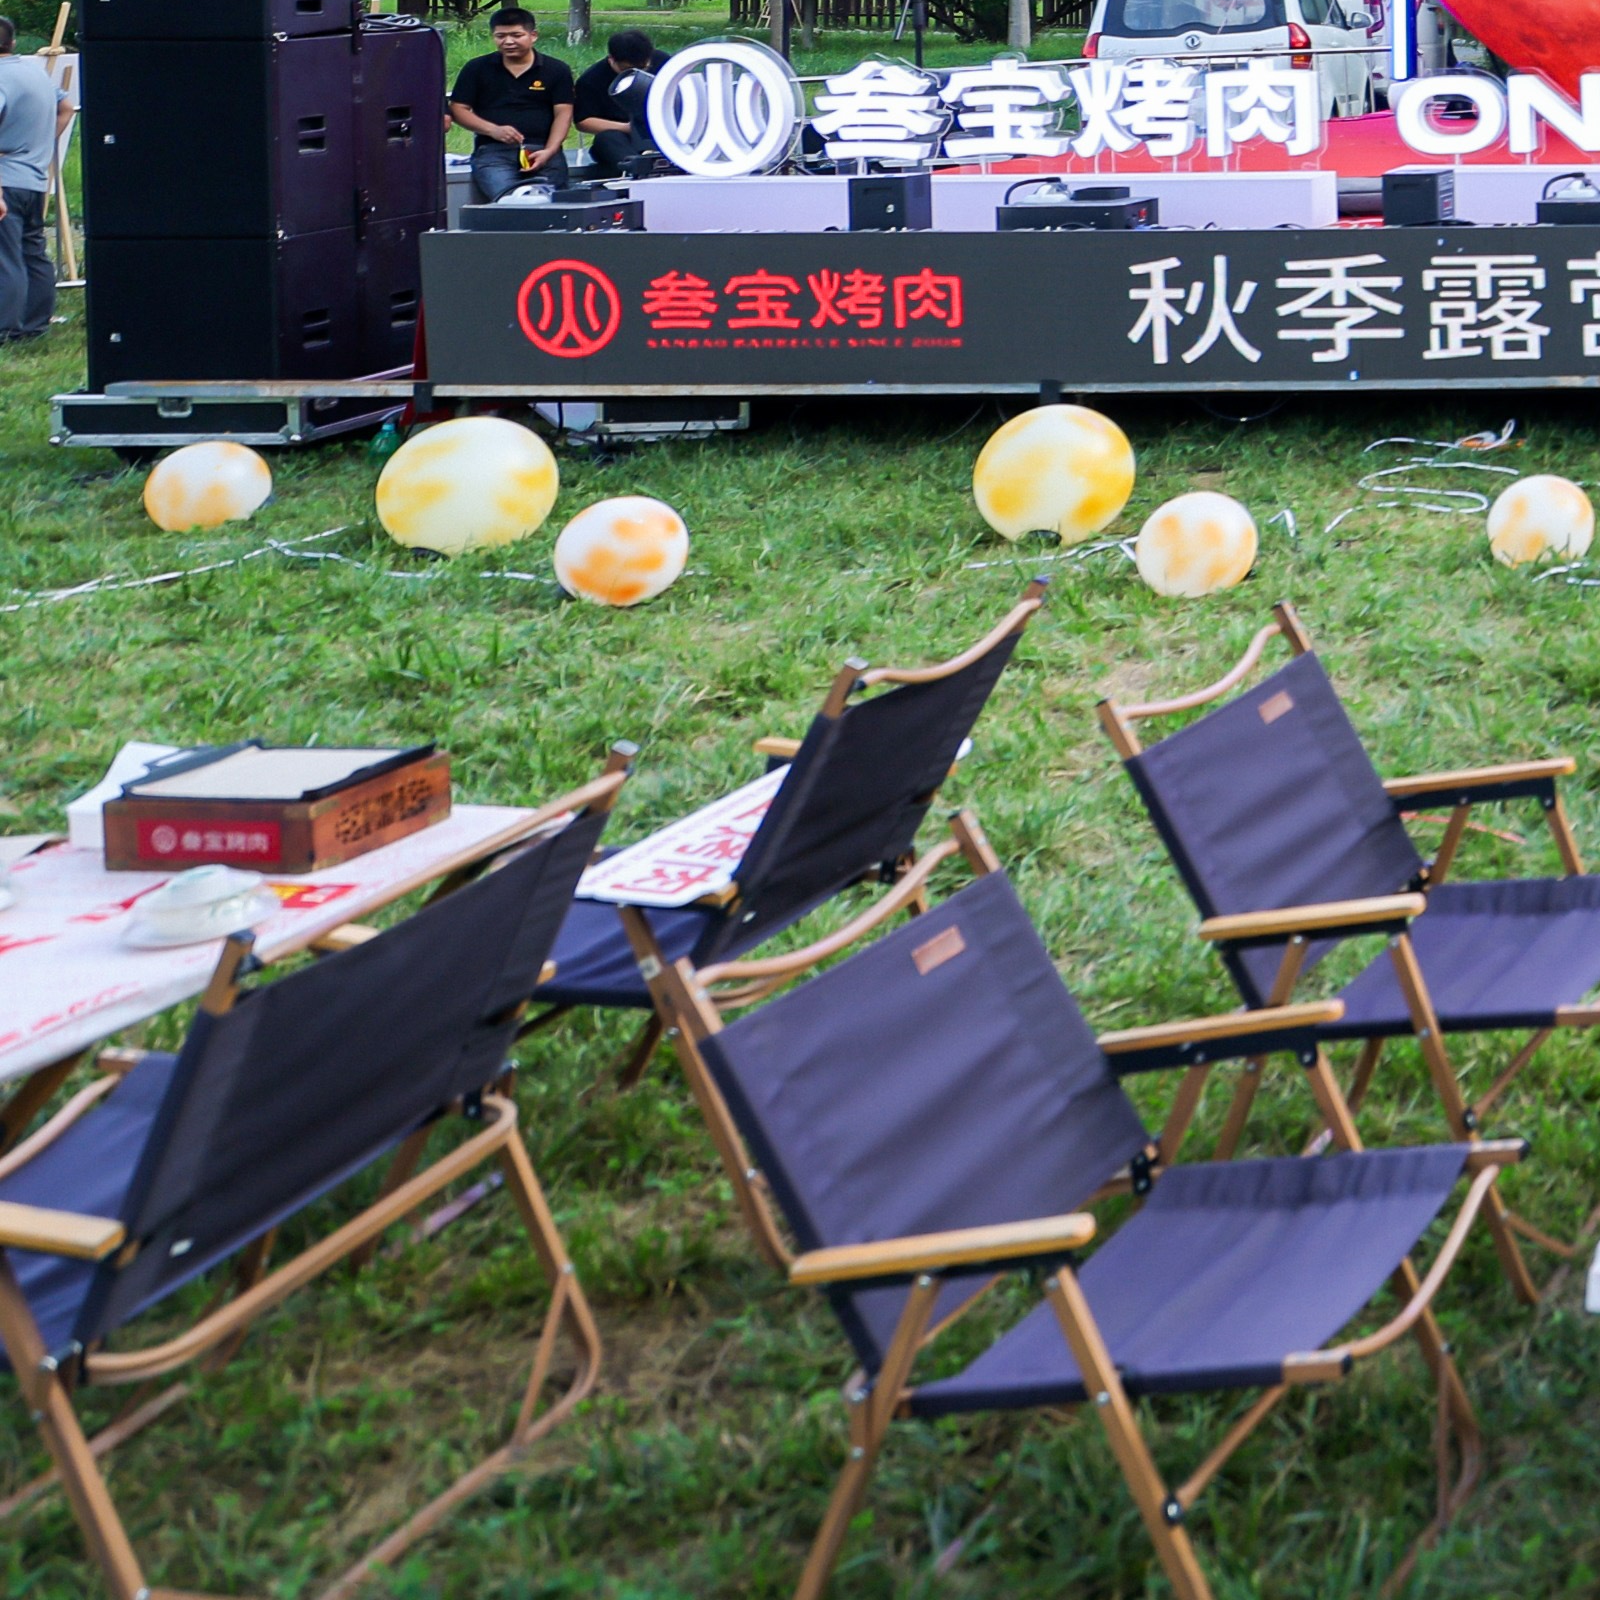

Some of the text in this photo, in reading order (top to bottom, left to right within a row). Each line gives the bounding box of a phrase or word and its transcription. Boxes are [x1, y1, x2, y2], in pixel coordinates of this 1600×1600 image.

[812, 57, 1322, 163] 叁宝烤肉
[642, 267, 965, 331] 叁宝烤肉
